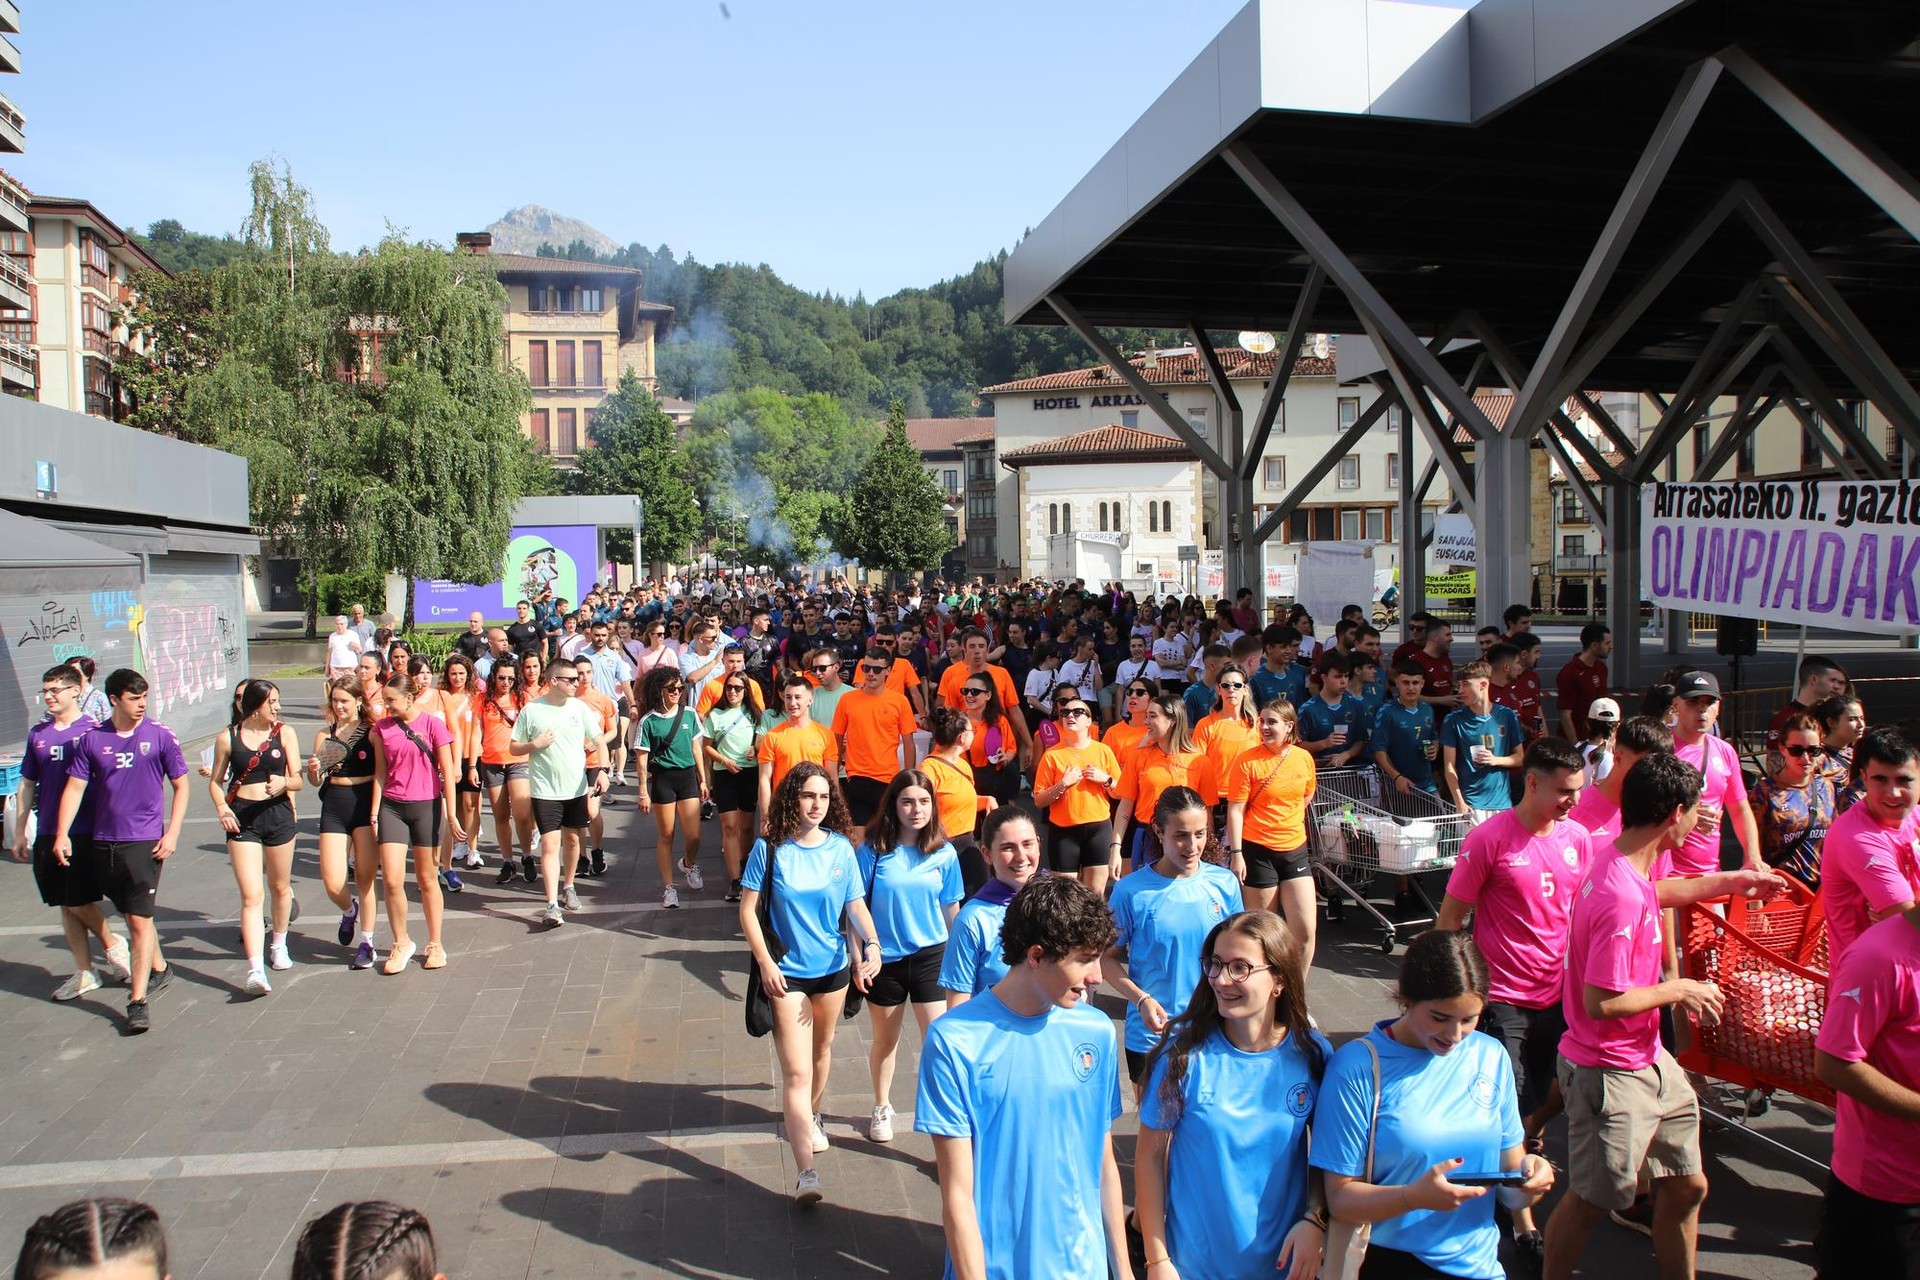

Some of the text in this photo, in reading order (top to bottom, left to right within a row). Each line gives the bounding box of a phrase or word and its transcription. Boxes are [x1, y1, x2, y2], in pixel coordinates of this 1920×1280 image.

[1034, 392, 1169, 411] HOTEL ARRASE
[1456, 536, 1476, 547] JUA
[1436, 548, 1476, 562] EUSKAR
[1651, 525, 1920, 625] OLINPIADAK
[1414, 726, 1422, 740] 7
[1481, 734, 1495, 749] 10
[115, 752, 134, 769] 32
[1541, 872, 1555, 898] 5
